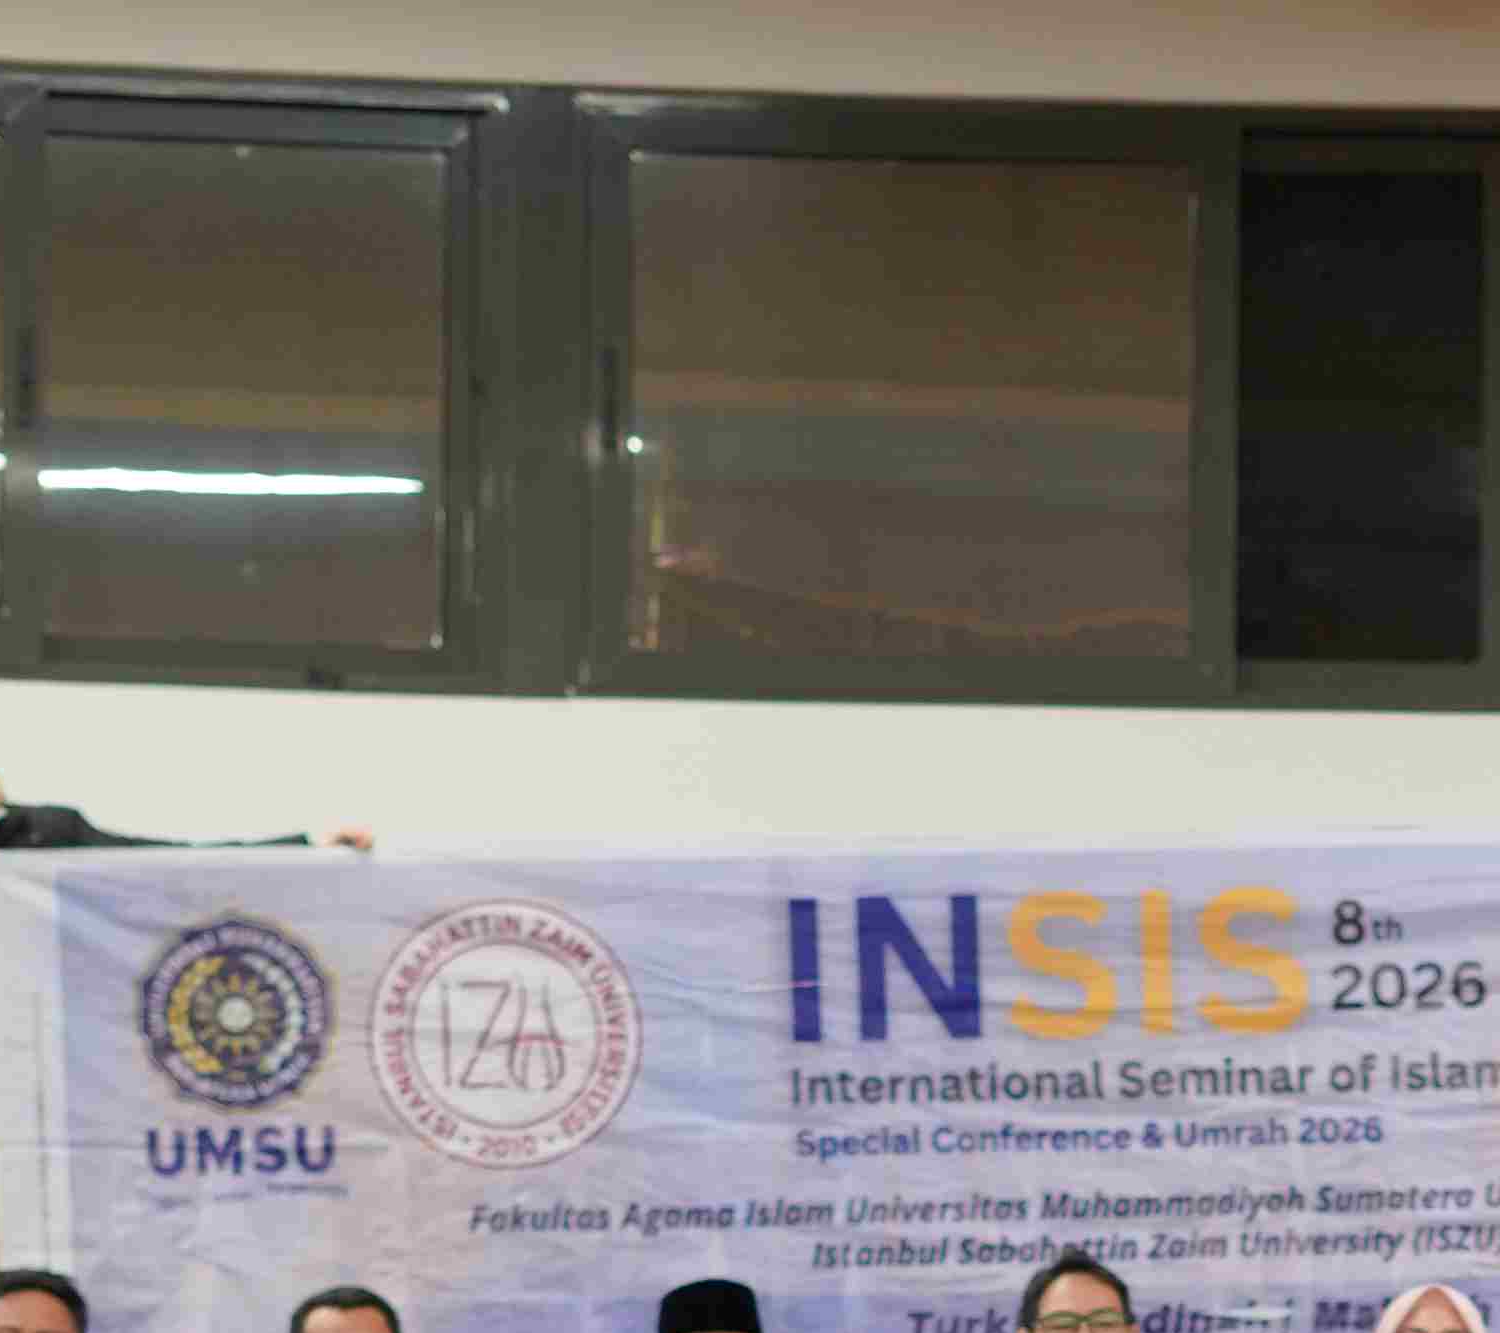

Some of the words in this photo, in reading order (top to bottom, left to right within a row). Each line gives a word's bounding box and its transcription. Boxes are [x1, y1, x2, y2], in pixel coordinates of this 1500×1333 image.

[1332, 899, 1404, 946] 8th
[788, 887, 1310, 1042] INSIS
[1330, 962, 1488, 1010] 2026
[791, 1059, 1104, 1106] International
[1118, 1057, 1313, 1100] Seminar
[1330, 1053, 1377, 1093] of
[145, 1125, 336, 1178] UMSU
[798, 1125, 921, 1161] Special
[931, 1122, 1131, 1155] Conference
[1141, 1122, 1165, 1151] &
[1174, 1117, 1288, 1149] Umrah
[1299, 1116, 1384, 1146] 2026
[469, 1203, 611, 1233] Fakultas
[621, 1203, 736, 1238] Agama
[745, 1197, 835, 1230] Islam
[846, 1196, 1028, 1228] Universitas
[1041, 1187, 1306, 1226] Muhammadiyah
[1315, 1184, 1474, 1214] Sumatera
[813, 1238, 949, 1271] Istanbul
[1148, 1231, 1229, 1260] Zaim
[1239, 1222, 1404, 1262] University
